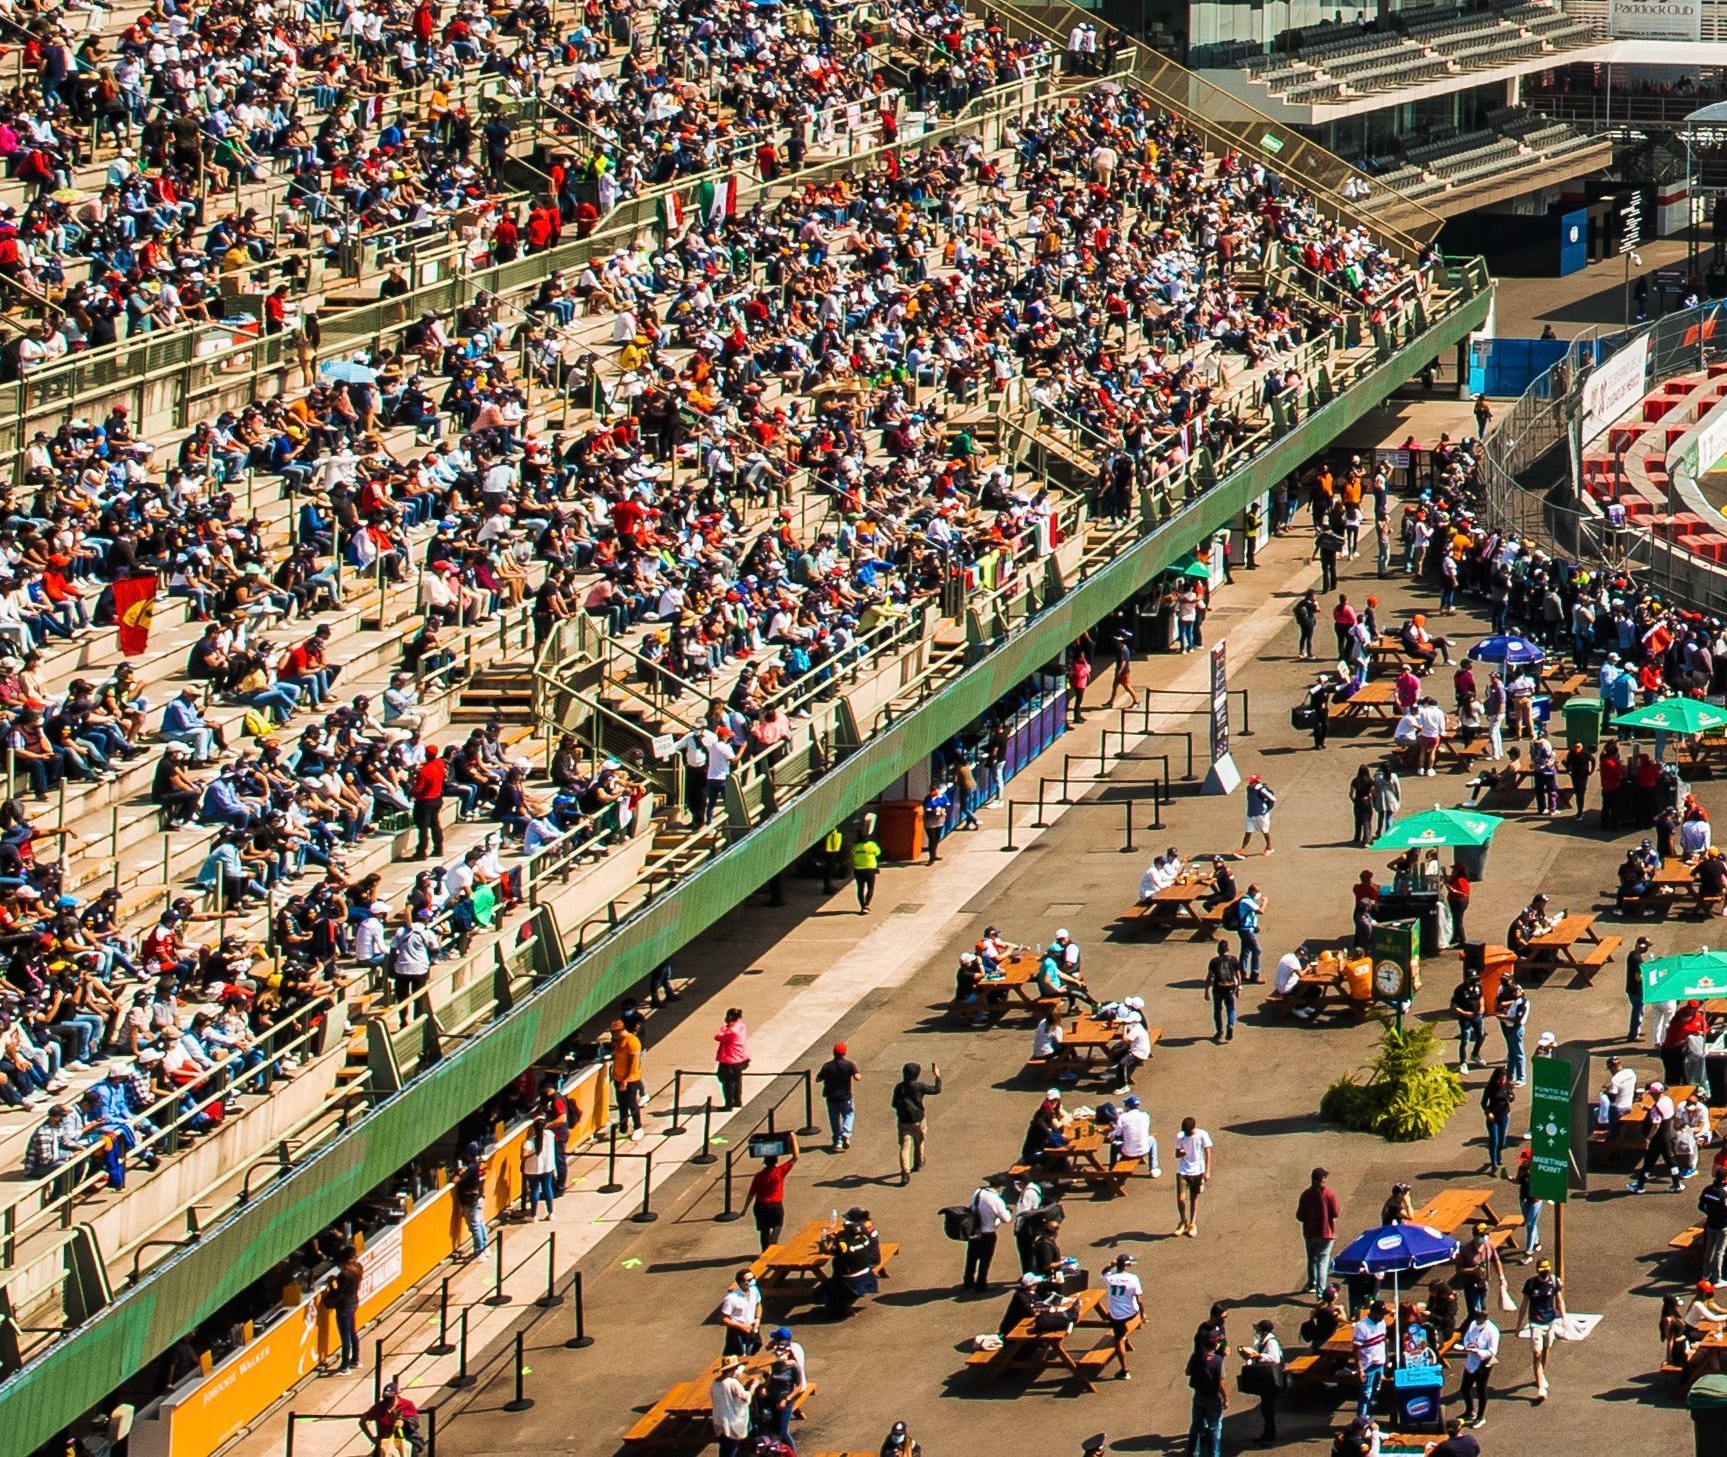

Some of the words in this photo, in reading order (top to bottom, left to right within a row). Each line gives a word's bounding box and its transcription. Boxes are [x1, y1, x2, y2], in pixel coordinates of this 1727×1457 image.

[1614, 2, 1666, 16] Paddock
[1667, 3, 1695, 16] Club
[1532, 1155, 1568, 1168] MEETING
[1538, 1164, 1562, 1174] POINT
